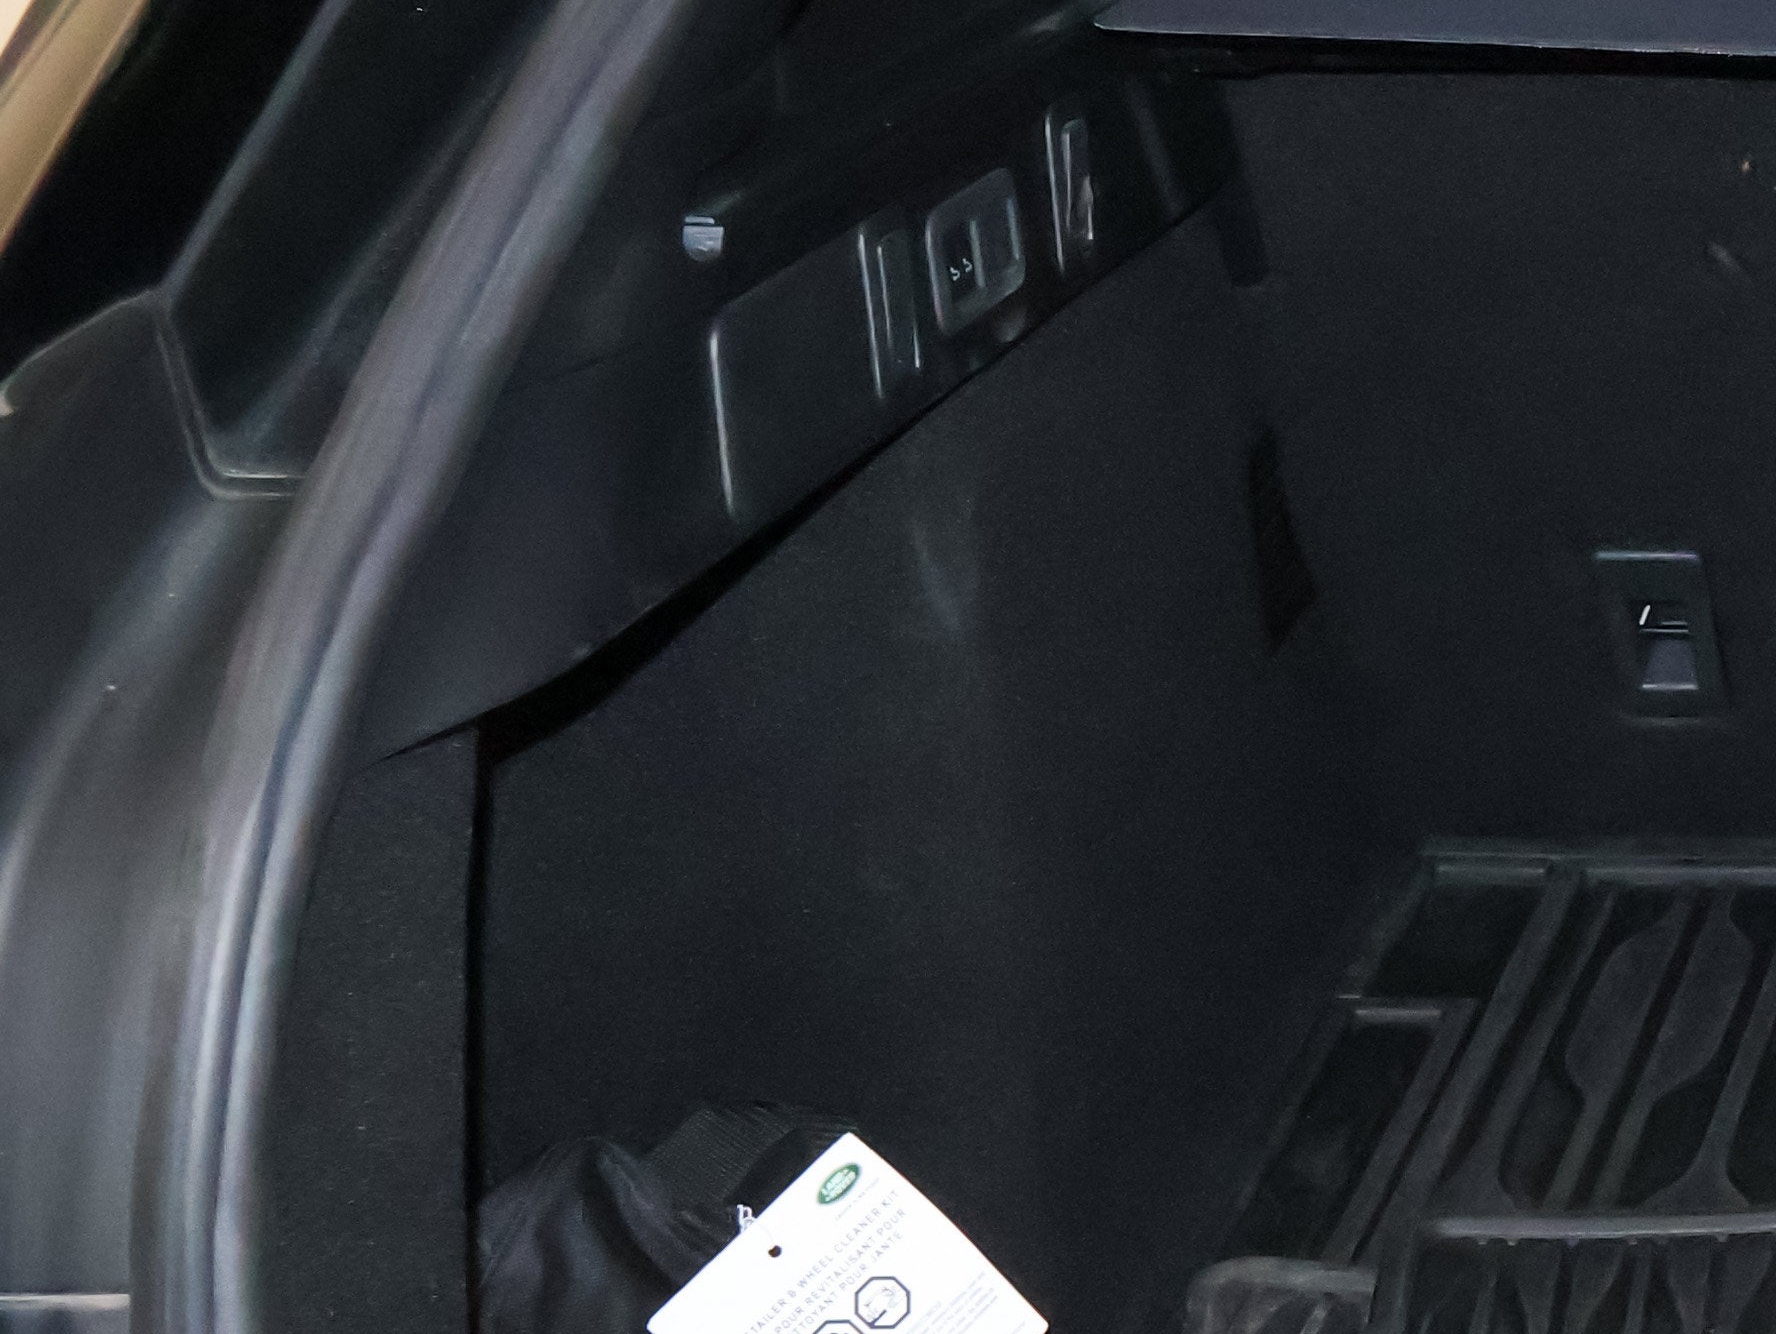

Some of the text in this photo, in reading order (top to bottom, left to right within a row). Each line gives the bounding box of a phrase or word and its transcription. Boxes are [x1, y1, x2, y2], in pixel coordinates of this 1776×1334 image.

[774, 1306, 804, 1334] POUR
[804, 1236, 876, 1305] REVITALISANT
[877, 1208, 905, 1235] POUR
[796, 1253, 833, 1288] WHEEL
[834, 1208, 880, 1252] CLEANER
[881, 1190, 898, 1207] KIT
[839, 1263, 867, 1291] POUR
[869, 1230, 902, 1262] JANTE
